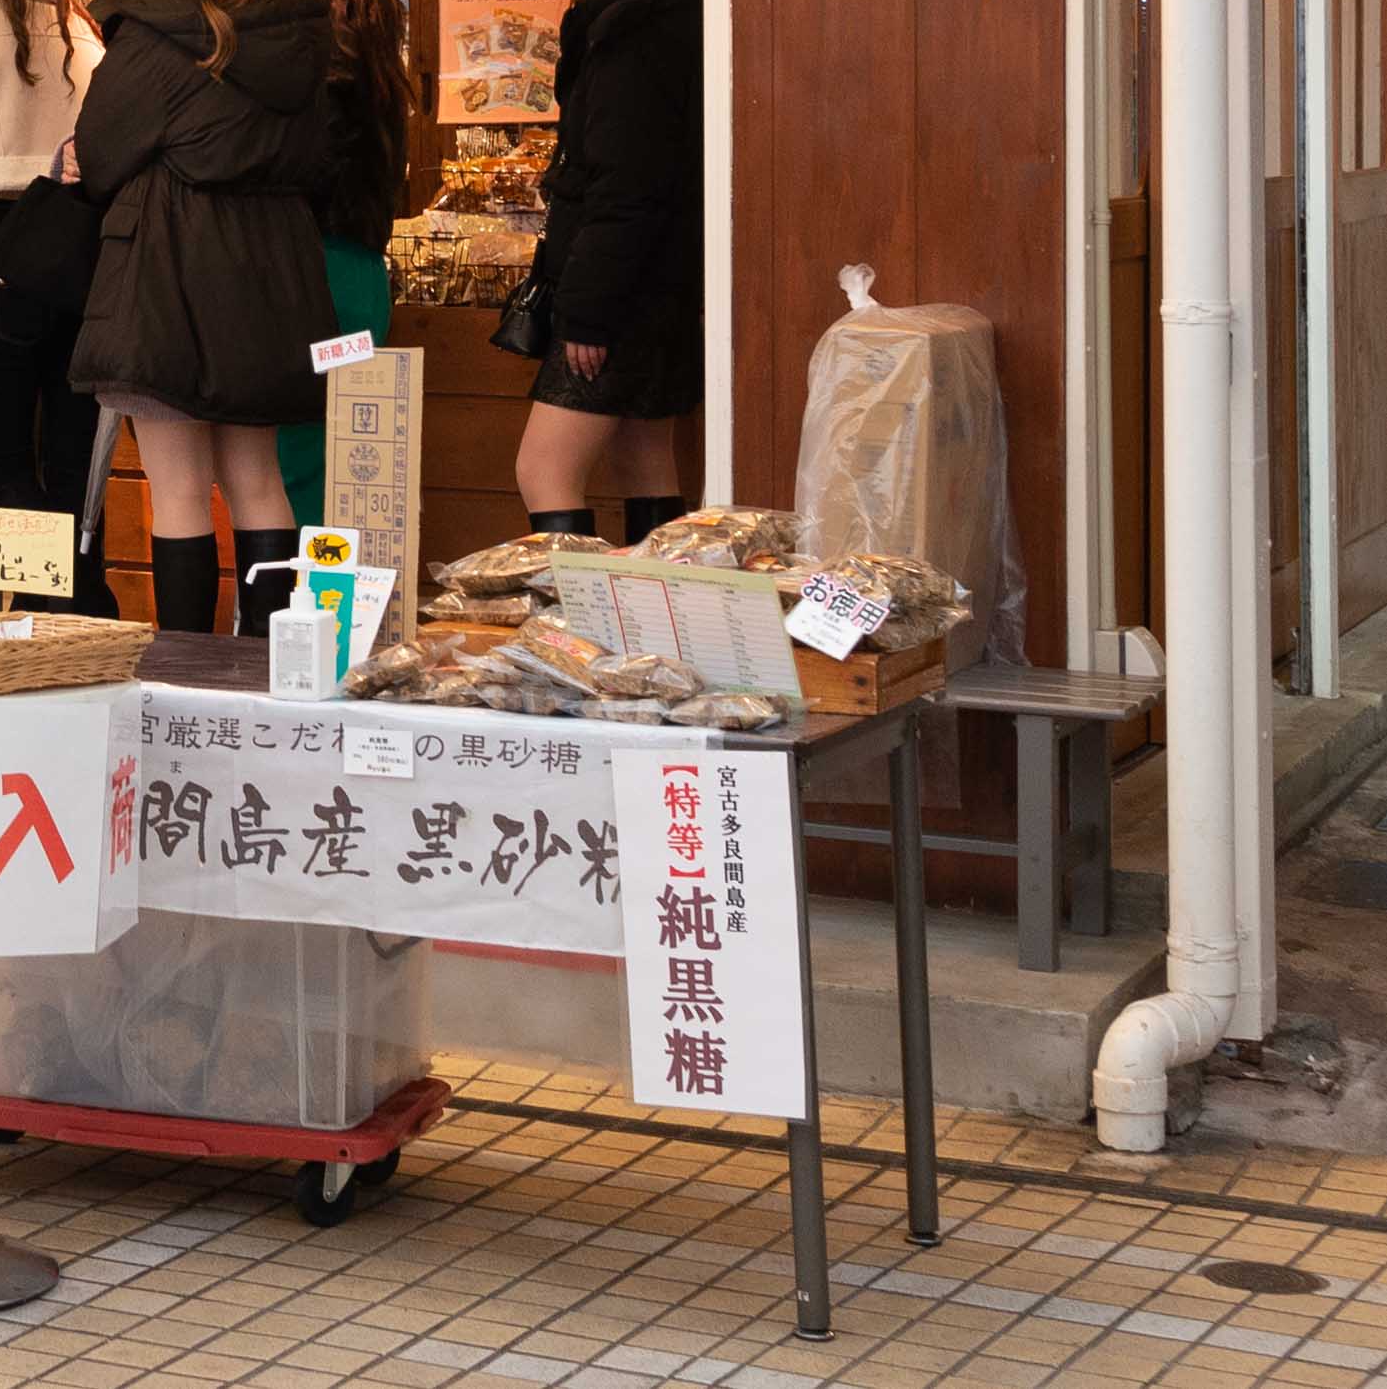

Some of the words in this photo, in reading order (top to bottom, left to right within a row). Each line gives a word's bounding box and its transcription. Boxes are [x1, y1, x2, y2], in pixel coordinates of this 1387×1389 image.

[370, 494, 390, 513] 30
[802, 575, 887, 633] お徳用
[141, 711, 583, 777] 宮厳選こだの黒砂糖
[170, 760, 183, 775] ま
[717, 766, 749, 934] 宮古多良間島産
